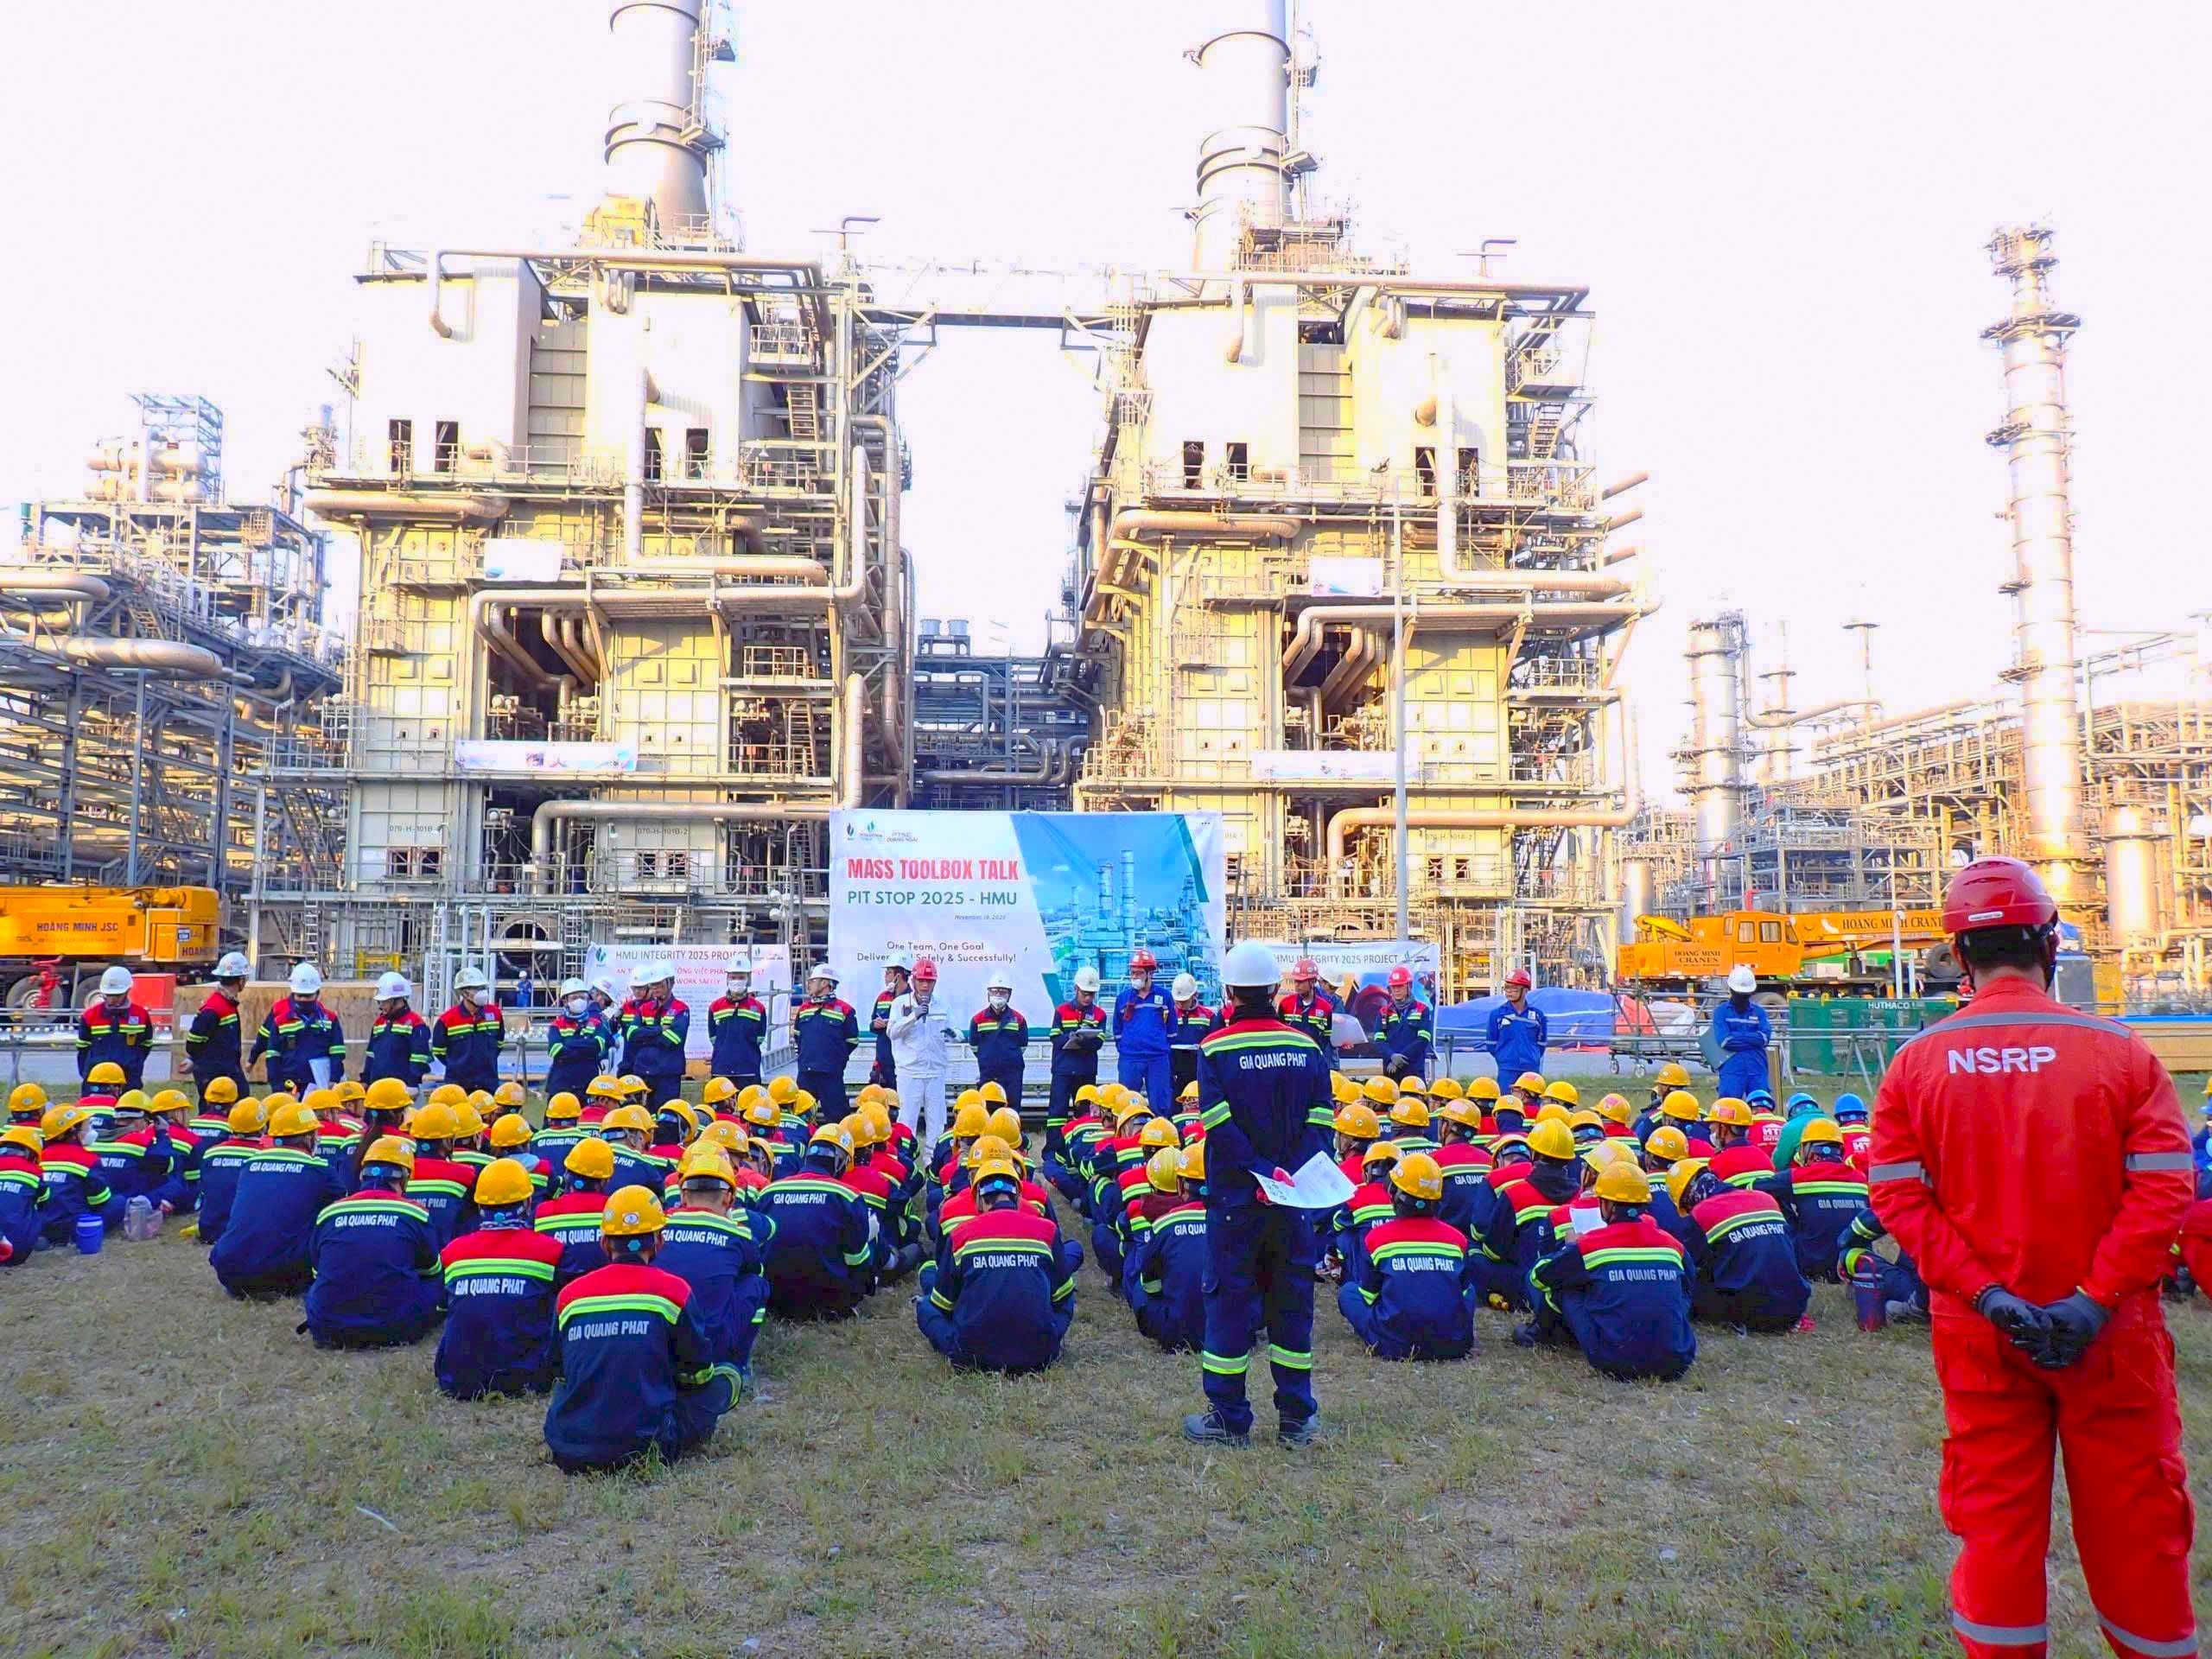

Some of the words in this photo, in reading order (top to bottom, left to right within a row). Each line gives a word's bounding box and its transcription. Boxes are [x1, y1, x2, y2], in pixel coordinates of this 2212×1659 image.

[848, 859, 894, 879] MASS
[899, 859, 973, 880] TOOLBOX
[978, 860, 1019, 880] TALK
[848, 891, 870, 905] PIT
[875, 891, 916, 905] STOP
[921, 892, 964, 906] 2025
[980, 892, 1017, 906] HMU
[73, 923, 97, 931] MINH
[100, 923, 118, 931] JSC
[1880, 918, 1908, 929] MIH
[1910, 917, 1942, 928] CRANE
[887, 940, 905, 950] One
[907, 941, 936, 952] Team,
[939, 942, 959, 951] One
[962, 942, 984, 950] Goal
[616, 951, 639, 960] HMU
[640, 950, 685, 960] INTEGRITY
[689, 950, 709, 960] 2025
[916, 953, 945, 964] Safely
[948, 953, 955, 962] &
[957, 953, 1016, 964] Successfully!
[1297, 954, 1338, 963] INEGRITY
[1342, 955, 1361, 964] 2025
[1363, 955, 1398, 964] PROJECT
[1239, 1056, 1254, 1070] GIA
[1254, 1052, 1287, 1070] QUANG
[1287, 1052, 1307, 1067] PHAT
[1948, 1046, 2056, 1074] NSRP
[261, 1161, 285, 1173] QUANG
[285, 1163, 304, 1173] PHAT
[618, 1156, 635, 1166] PHAT
[1454, 1175, 1466, 1185] GIA
[428, 1198, 448, 1209] PHAT
[773, 1194, 785, 1205] GIA
[785, 1193, 810, 1205] QUANG
[810, 1193, 827, 1204] PHAT
[334, 1216, 347, 1227] GIA
[348, 1215, 378, 1226] QUANG
[378, 1215, 398, 1227] PHAT
[554, 1230, 567, 1244] GIA
[568, 1229, 595, 1244] QUANG
[1174, 1225, 1187, 1236] GIA
[1728, 1230, 1744, 1243] GIA
[1743, 1225, 1768, 1239] QUANG
[1768, 1224, 1785, 1235] PHAT
[674, 1230, 705, 1243] QUANG
[705, 1234, 728, 1247] PHAT
[973, 1255, 987, 1268] GIA
[988, 1255, 1016, 1268] QUANG
[1017, 1255, 1039, 1267] PHAT
[1392, 1258, 1404, 1271] GIA
[1407, 1257, 1435, 1272] QUANG
[1435, 1258, 1455, 1272] PHAT
[1608, 1270, 1624, 1281] GIA
[1627, 1269, 1656, 1281] QUANG
[454, 1280, 468, 1295] GIA
[469, 1278, 500, 1295] QUANG
[500, 1278, 526, 1295] PHAT
[568, 1326, 582, 1341] GIA
[584, 1322, 619, 1338] QUANG
[620, 1320, 650, 1336] PHAT
